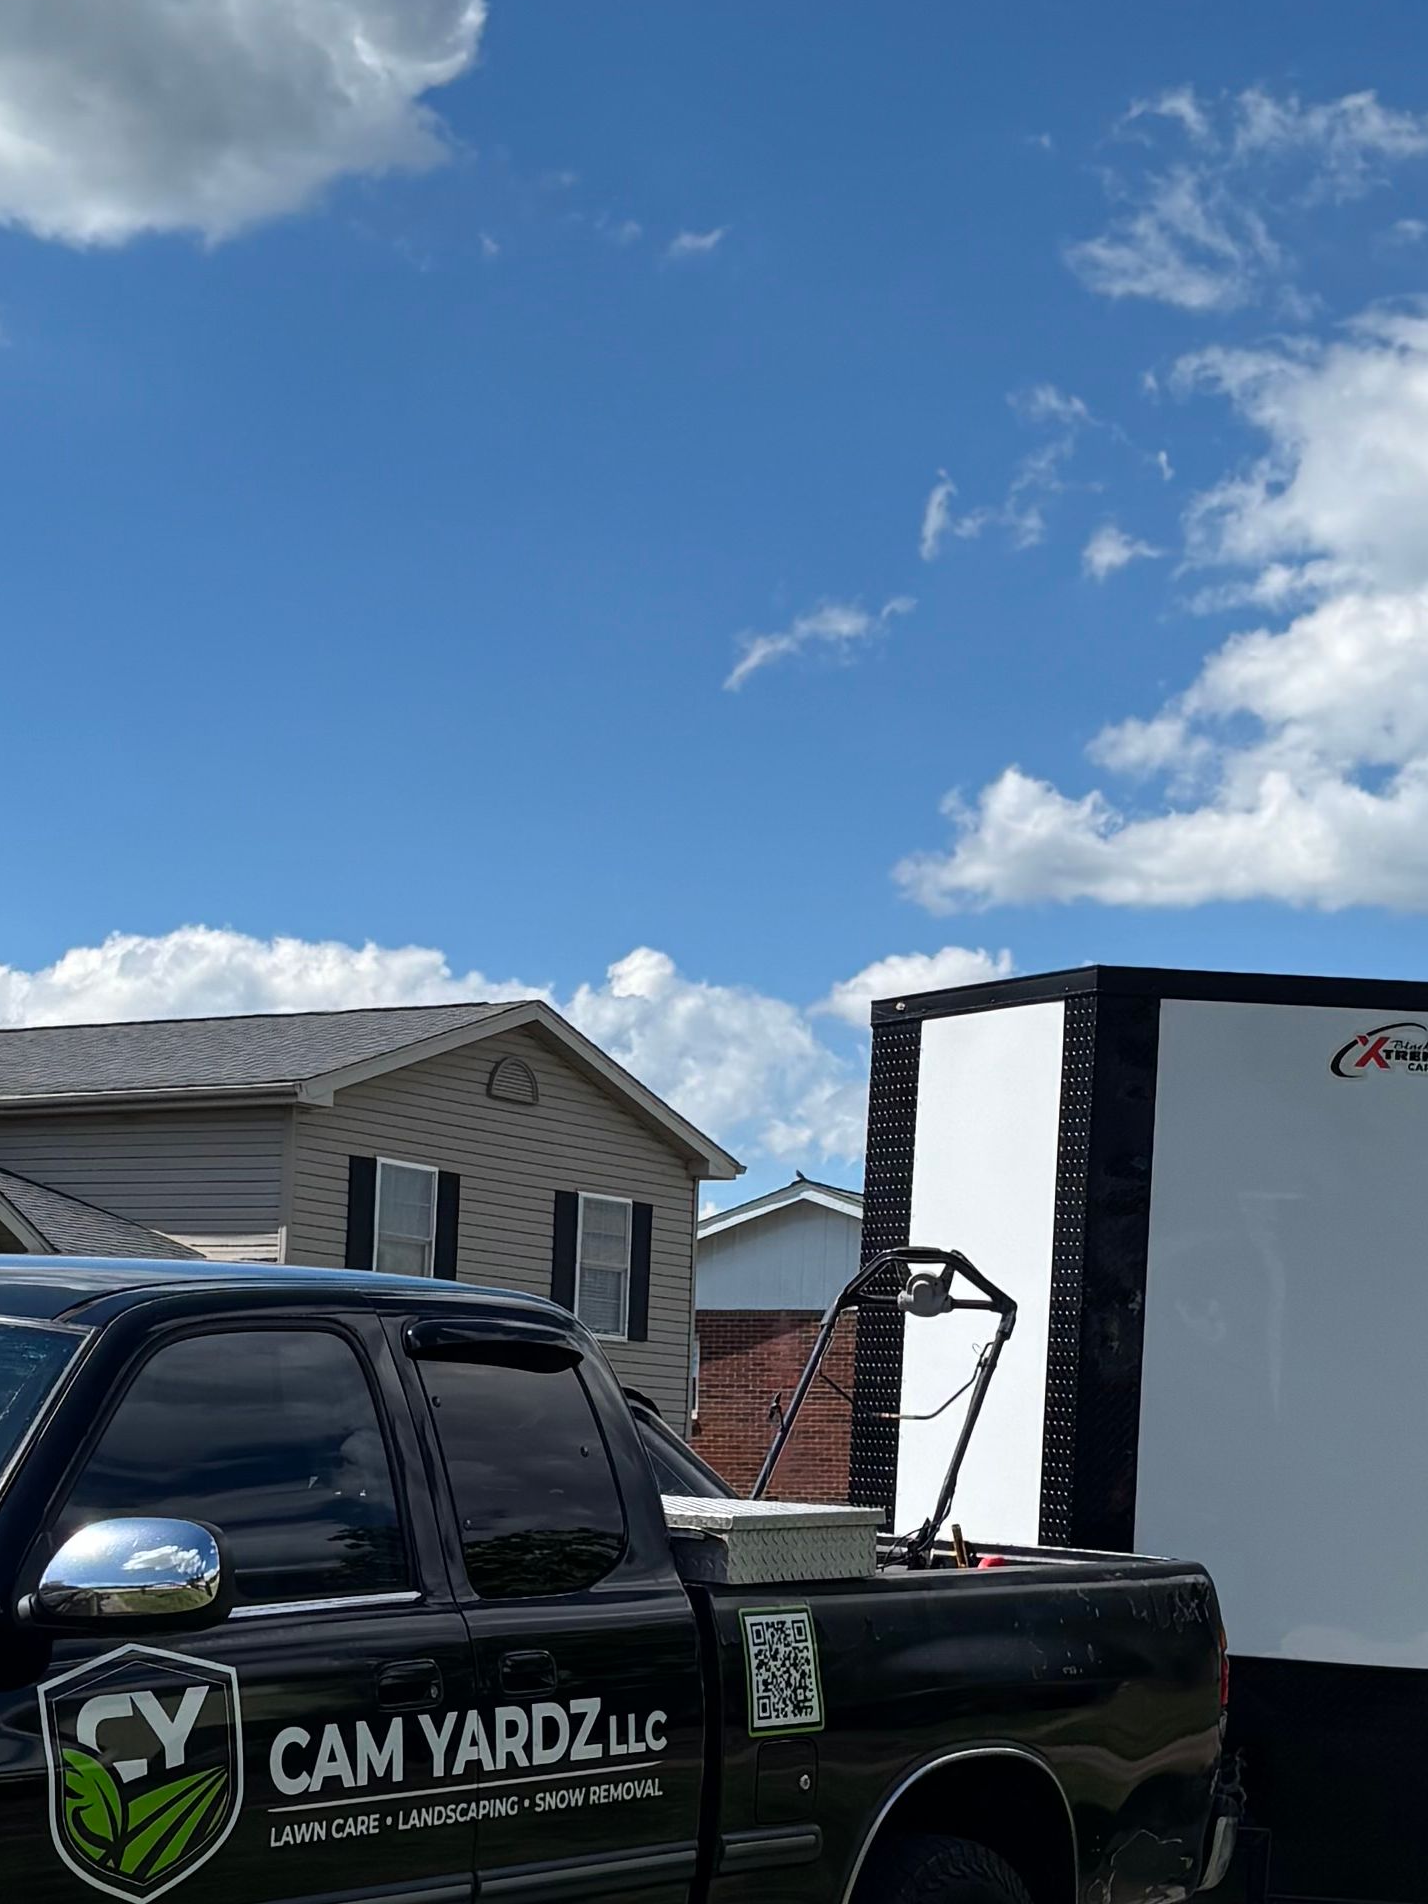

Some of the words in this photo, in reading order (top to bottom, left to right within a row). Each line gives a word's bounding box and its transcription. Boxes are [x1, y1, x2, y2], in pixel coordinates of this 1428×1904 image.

[76, 1686, 209, 1784] CY
[270, 1717, 404, 1795] CAM
[418, 1698, 603, 1778] YARDZ
[609, 1710, 668, 1756] LLC
[270, 1820, 326, 1848] LAWN
[331, 1814, 380, 1839] CARE
[398, 1797, 518, 1831] LANDSCAPING
[535, 1787, 586, 1813] SNOW
[589, 1778, 663, 1805] REMOVAL
